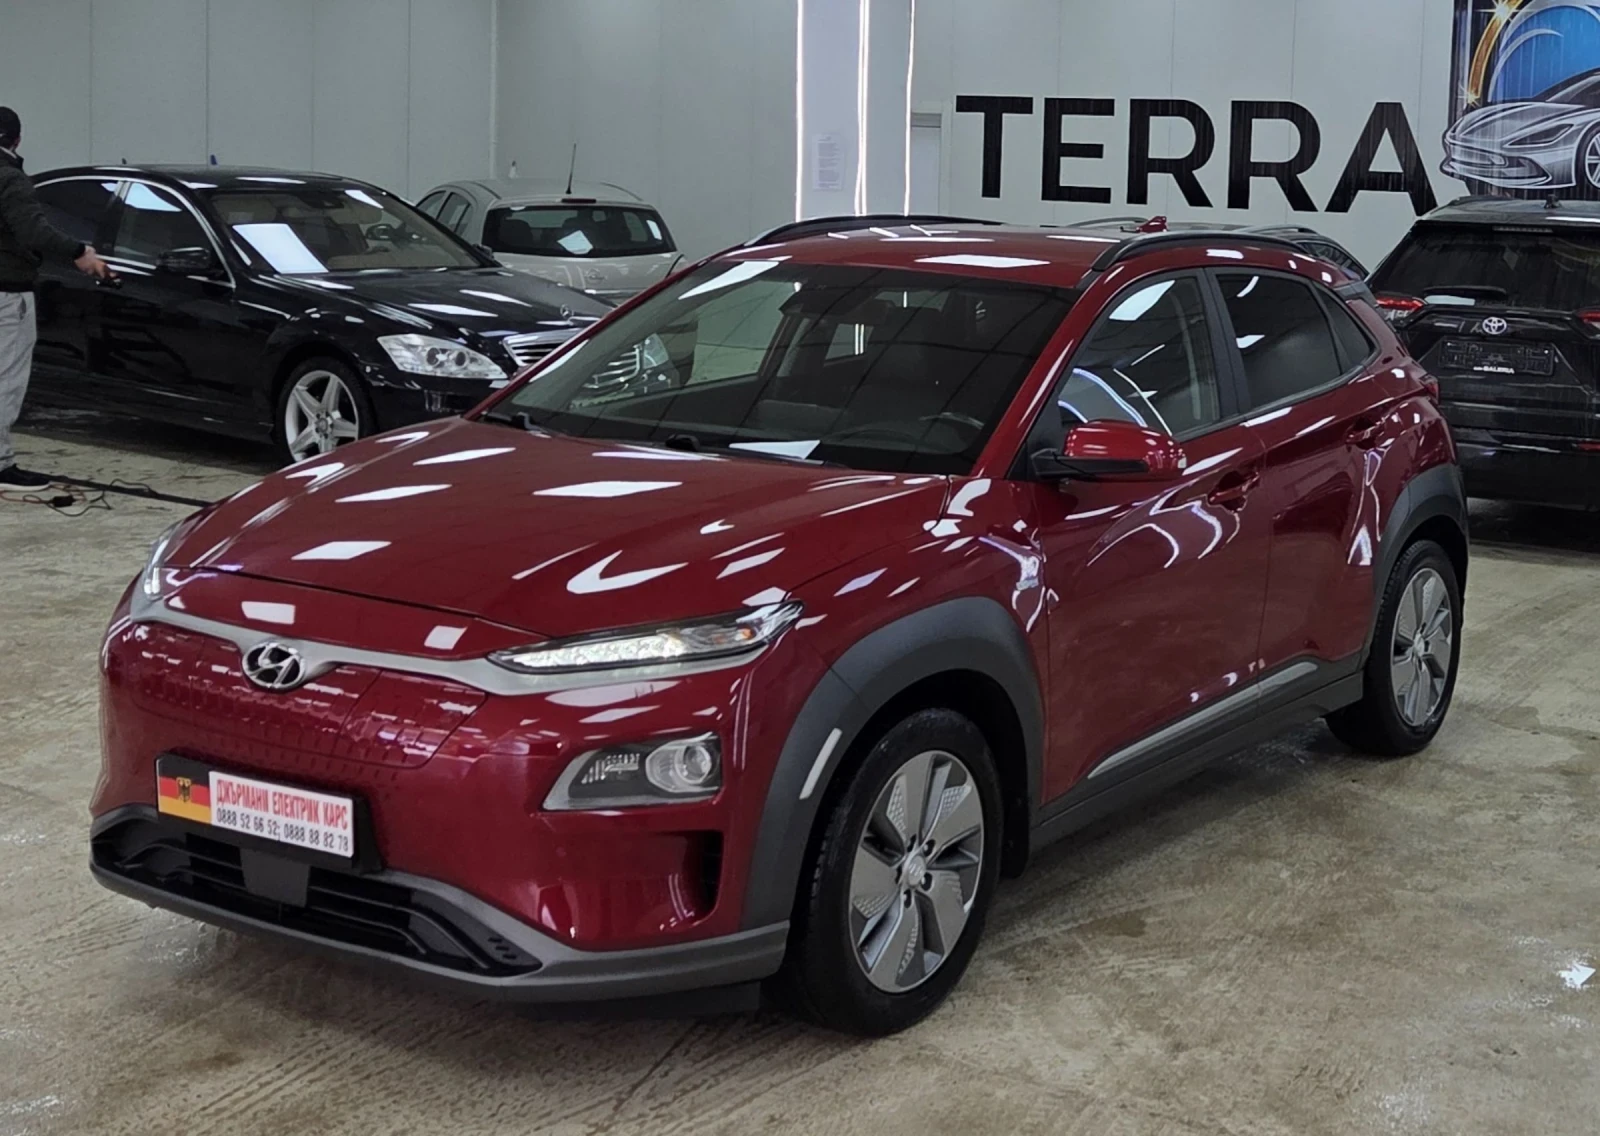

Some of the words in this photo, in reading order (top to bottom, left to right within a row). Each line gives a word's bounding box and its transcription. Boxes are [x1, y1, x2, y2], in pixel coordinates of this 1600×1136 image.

[956, 95, 1438, 217] TERRA
[216, 779, 269, 813] ДЖЪРМАНИ
[273, 792, 319, 823] ЕЛЕКТРИК
[323, 802, 348, 831] КАРС
[216, 807, 237, 827] 0888
[240, 812, 250, 828] 52
[283, 825, 306, 842] 0888
[308, 829, 320, 846] 88
[323, 832, 334, 848] 82
